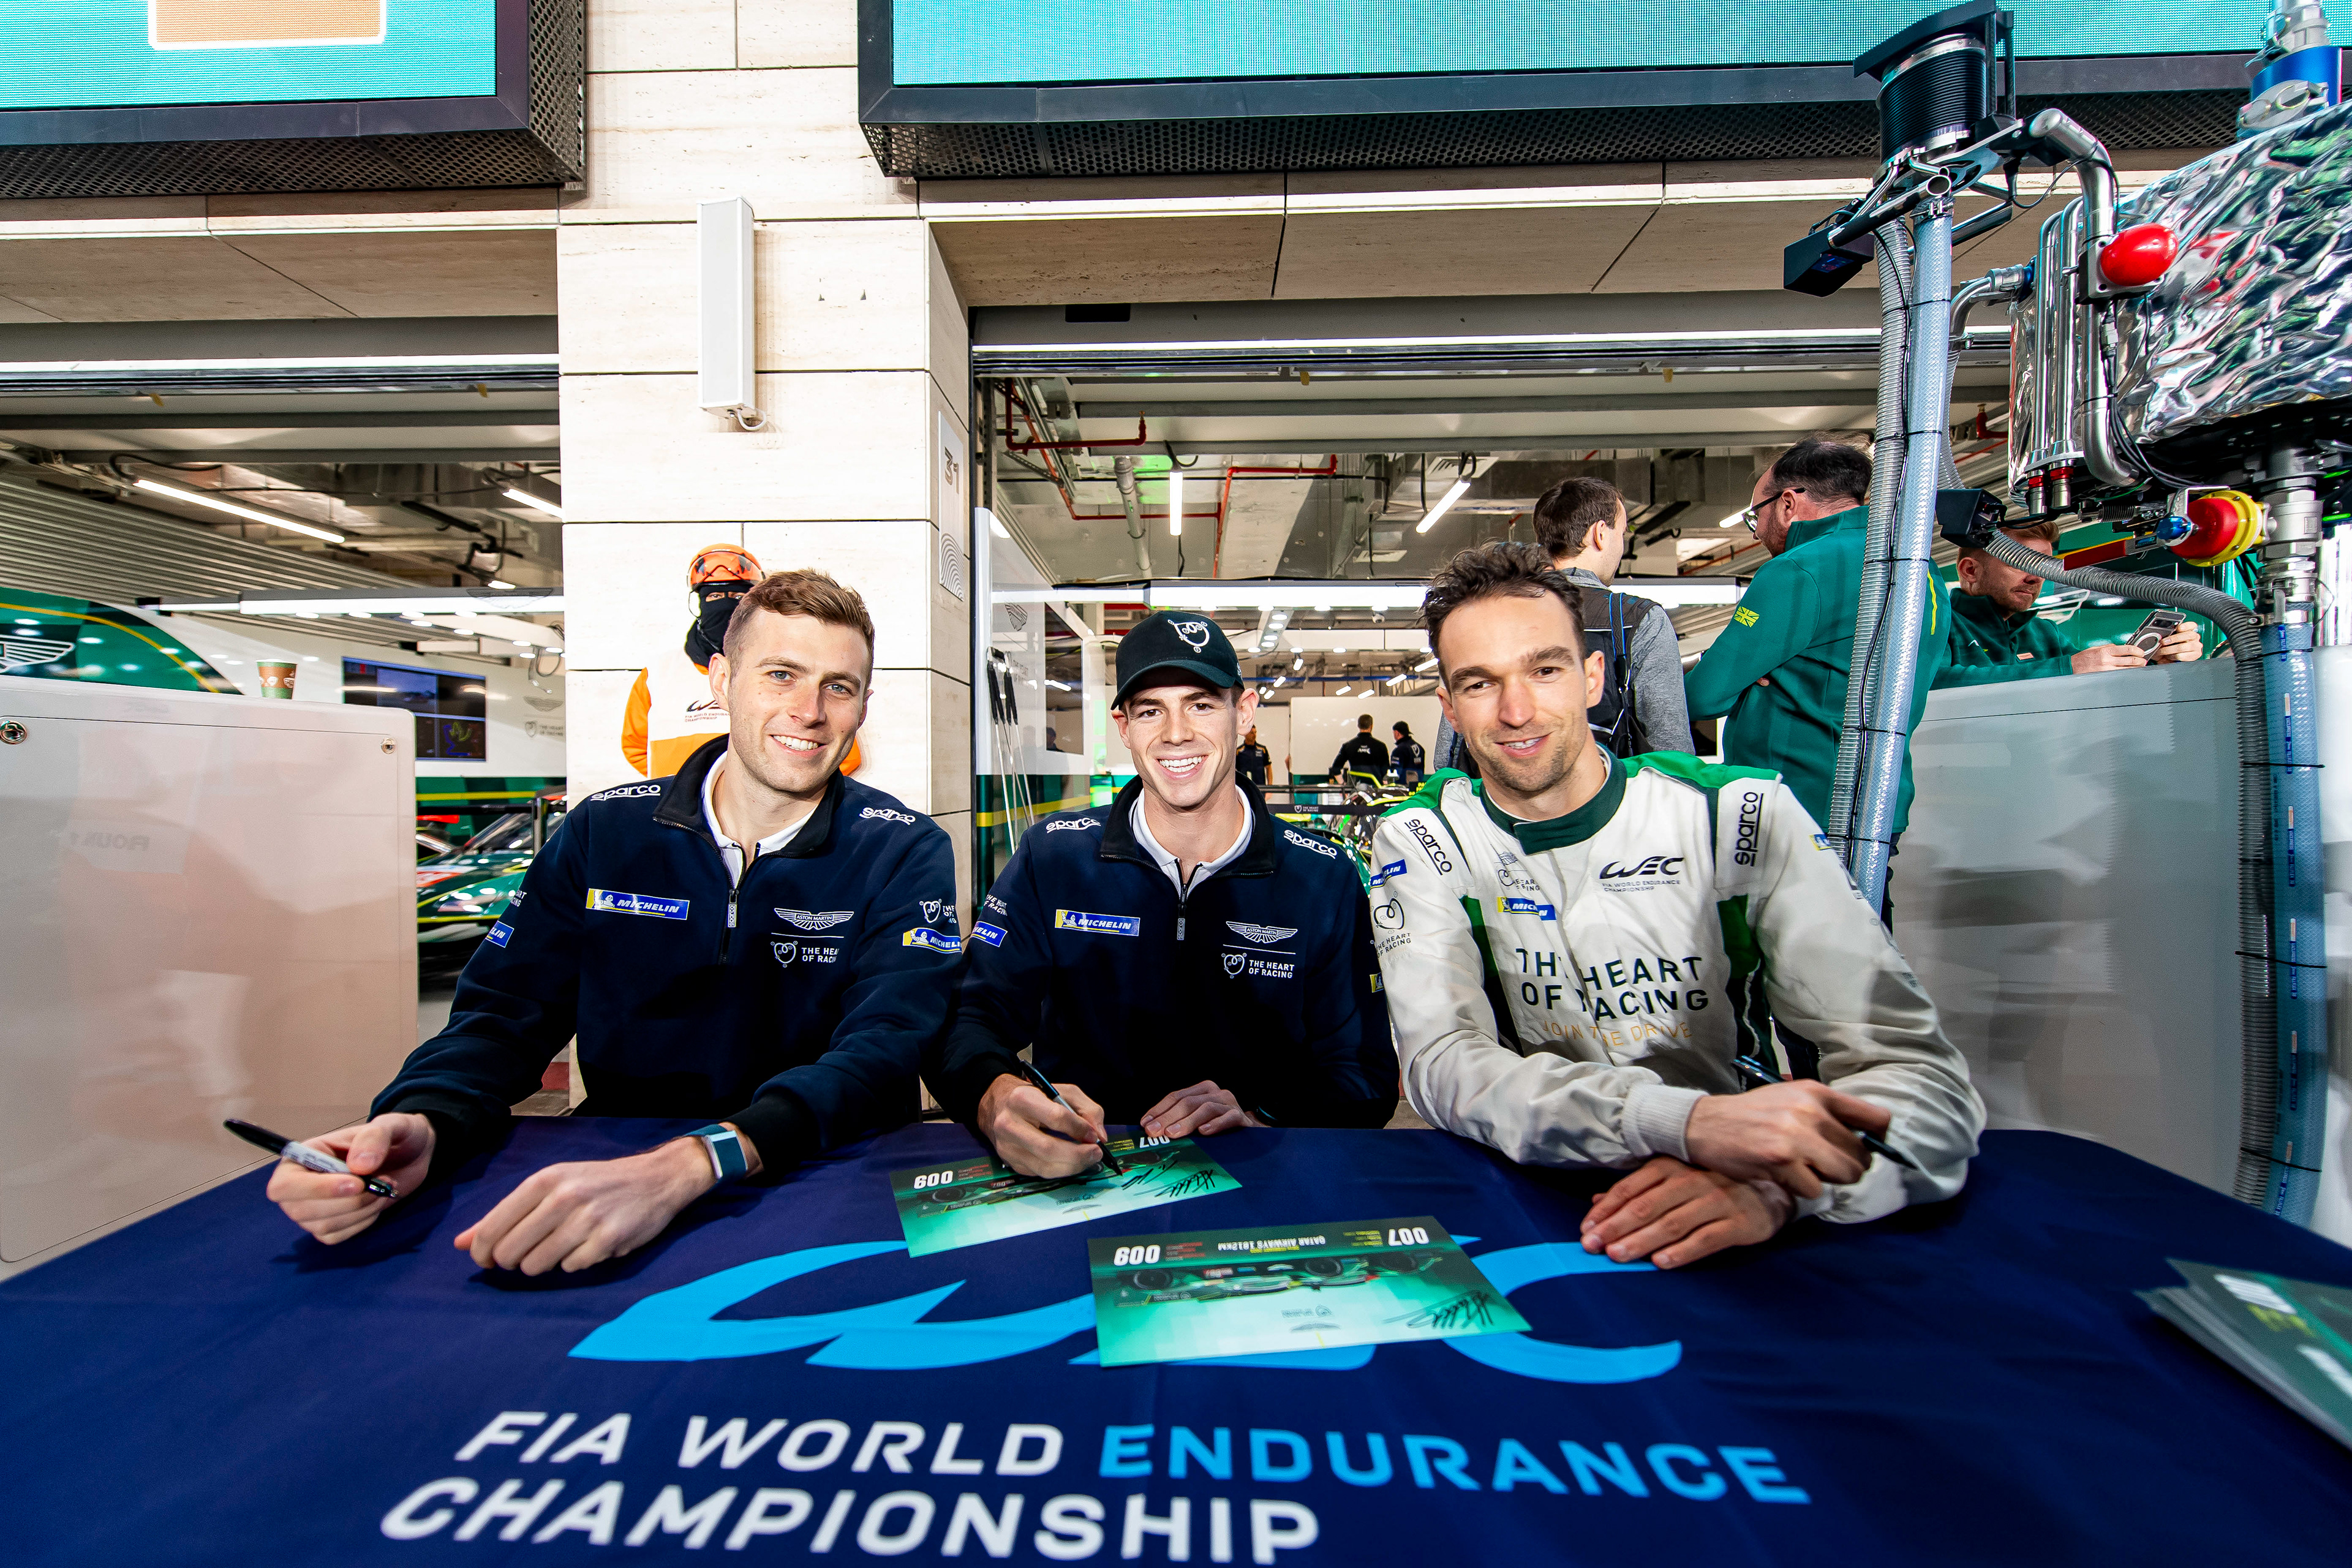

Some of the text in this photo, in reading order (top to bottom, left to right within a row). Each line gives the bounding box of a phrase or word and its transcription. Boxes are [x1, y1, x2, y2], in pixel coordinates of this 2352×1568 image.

[944, 446, 959, 494] 31
[590, 785, 661, 801] sparco
[859, 807, 916, 825] sparco
[1046, 817, 1101, 834] sparco
[1736, 792, 1764, 867] sparco
[1284, 829, 1338, 859] sparco
[1404, 818, 1452, 876] sparco
[1599, 856, 1684, 879] WEC
[617, 900, 680, 913] MICHELIN
[1078, 919, 1132, 930] MICHELIN
[1384, 938, 1411, 953] RACING
[1386, 933, 1411, 944] HEART
[1262, 969, 1293, 979] RACING
[1267, 962, 1295, 971] HEART
[1521, 982, 1562, 1010] OF
[1544, 1020, 1585, 1040] JOIN
[1630, 1022, 1692, 1042] DRIVE
[914, 1170, 953, 1189] 009
[1256, 1238, 1297, 1249] AIRWAYS
[1298, 1235, 1325, 1246] QATAR
[1389, 1227, 1429, 1246] 007
[1114, 1245, 1161, 1266] 009
[454, 1412, 1811, 1504] FIA WORLD ENDURANCE
[380, 1477, 1319, 1566] CHAMPIONSHIP
